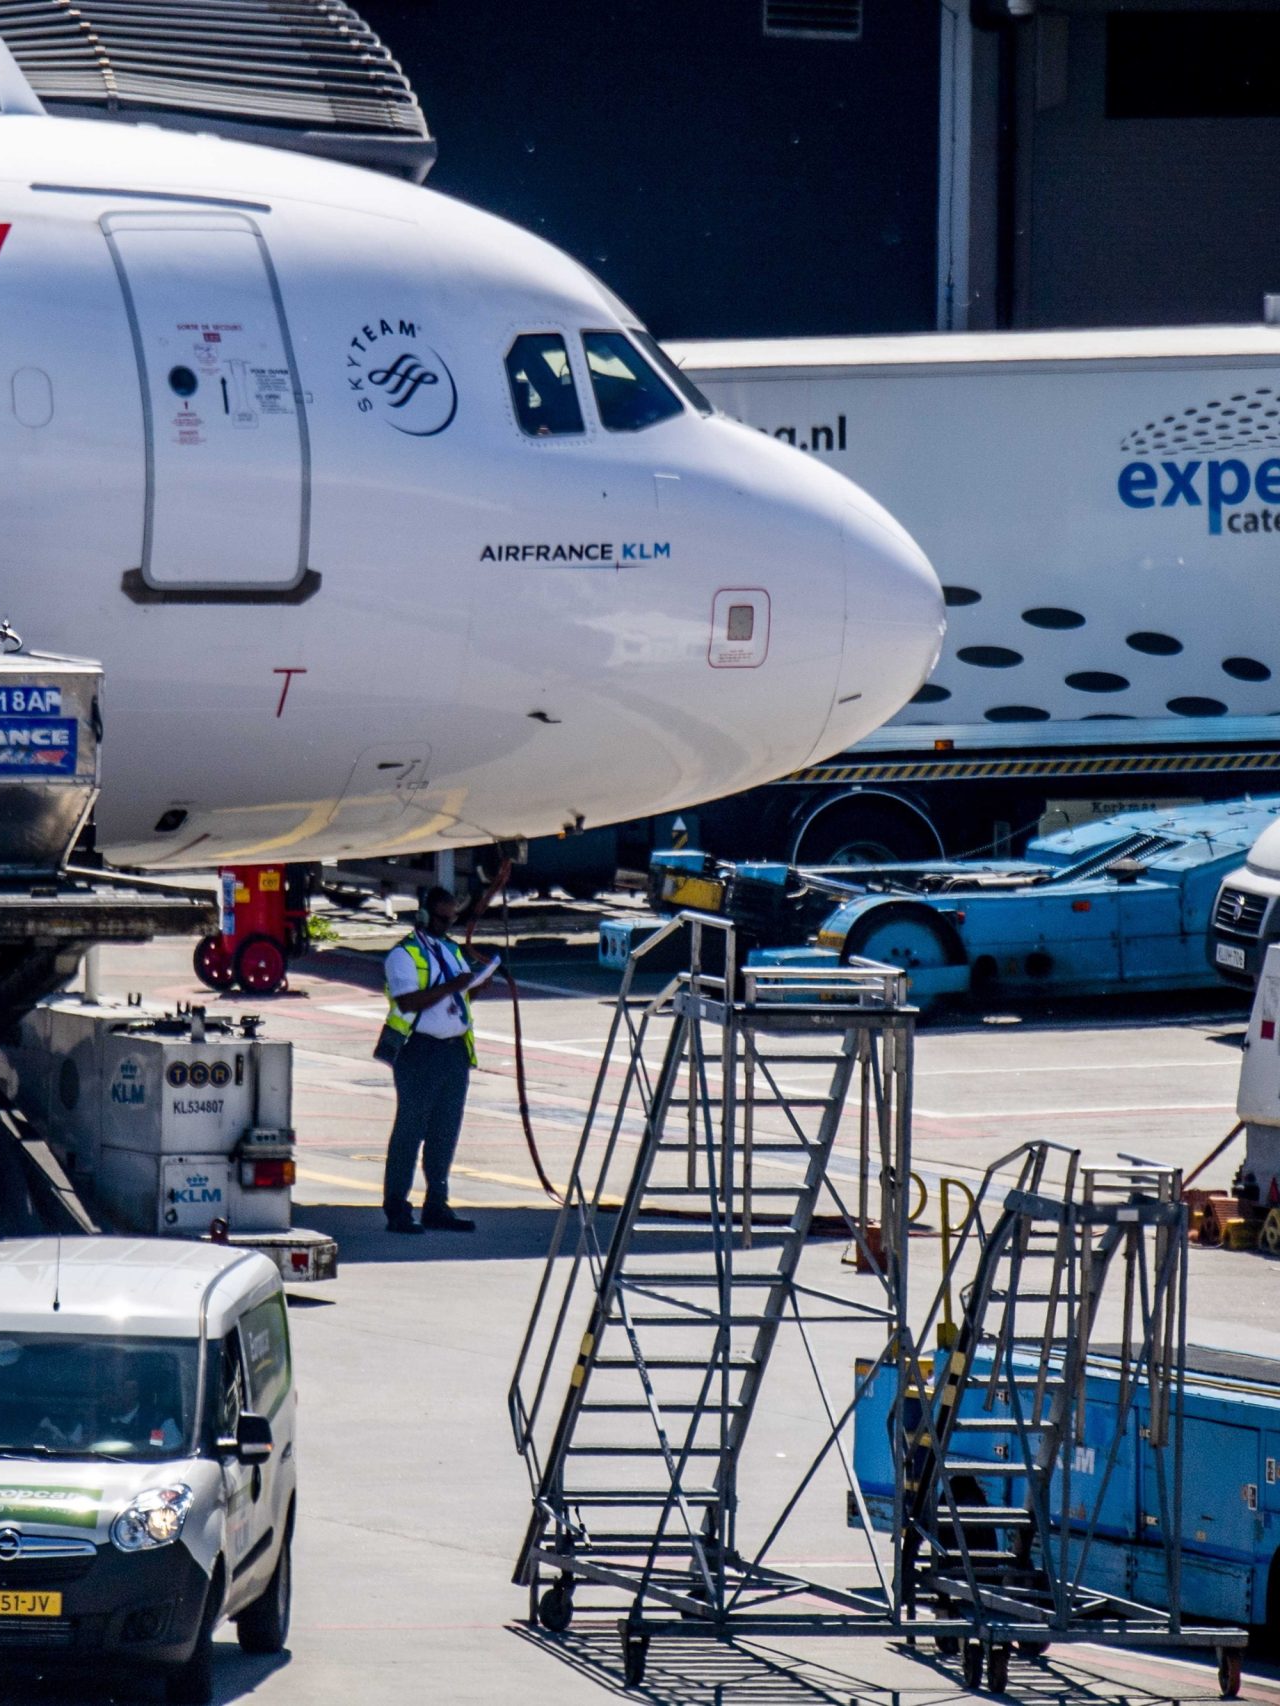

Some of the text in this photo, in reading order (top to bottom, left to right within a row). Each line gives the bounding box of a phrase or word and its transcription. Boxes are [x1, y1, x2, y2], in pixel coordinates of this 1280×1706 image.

[346, 318, 417, 413] SKYTEAM
[1118, 457, 1280, 535] expe
[479, 542, 670, 562] AIRFRANCE KLM
[110, 1083, 146, 1105] KLM
[173, 1100, 225, 1115] KL534807
[174, 1188, 222, 1203] KLM
